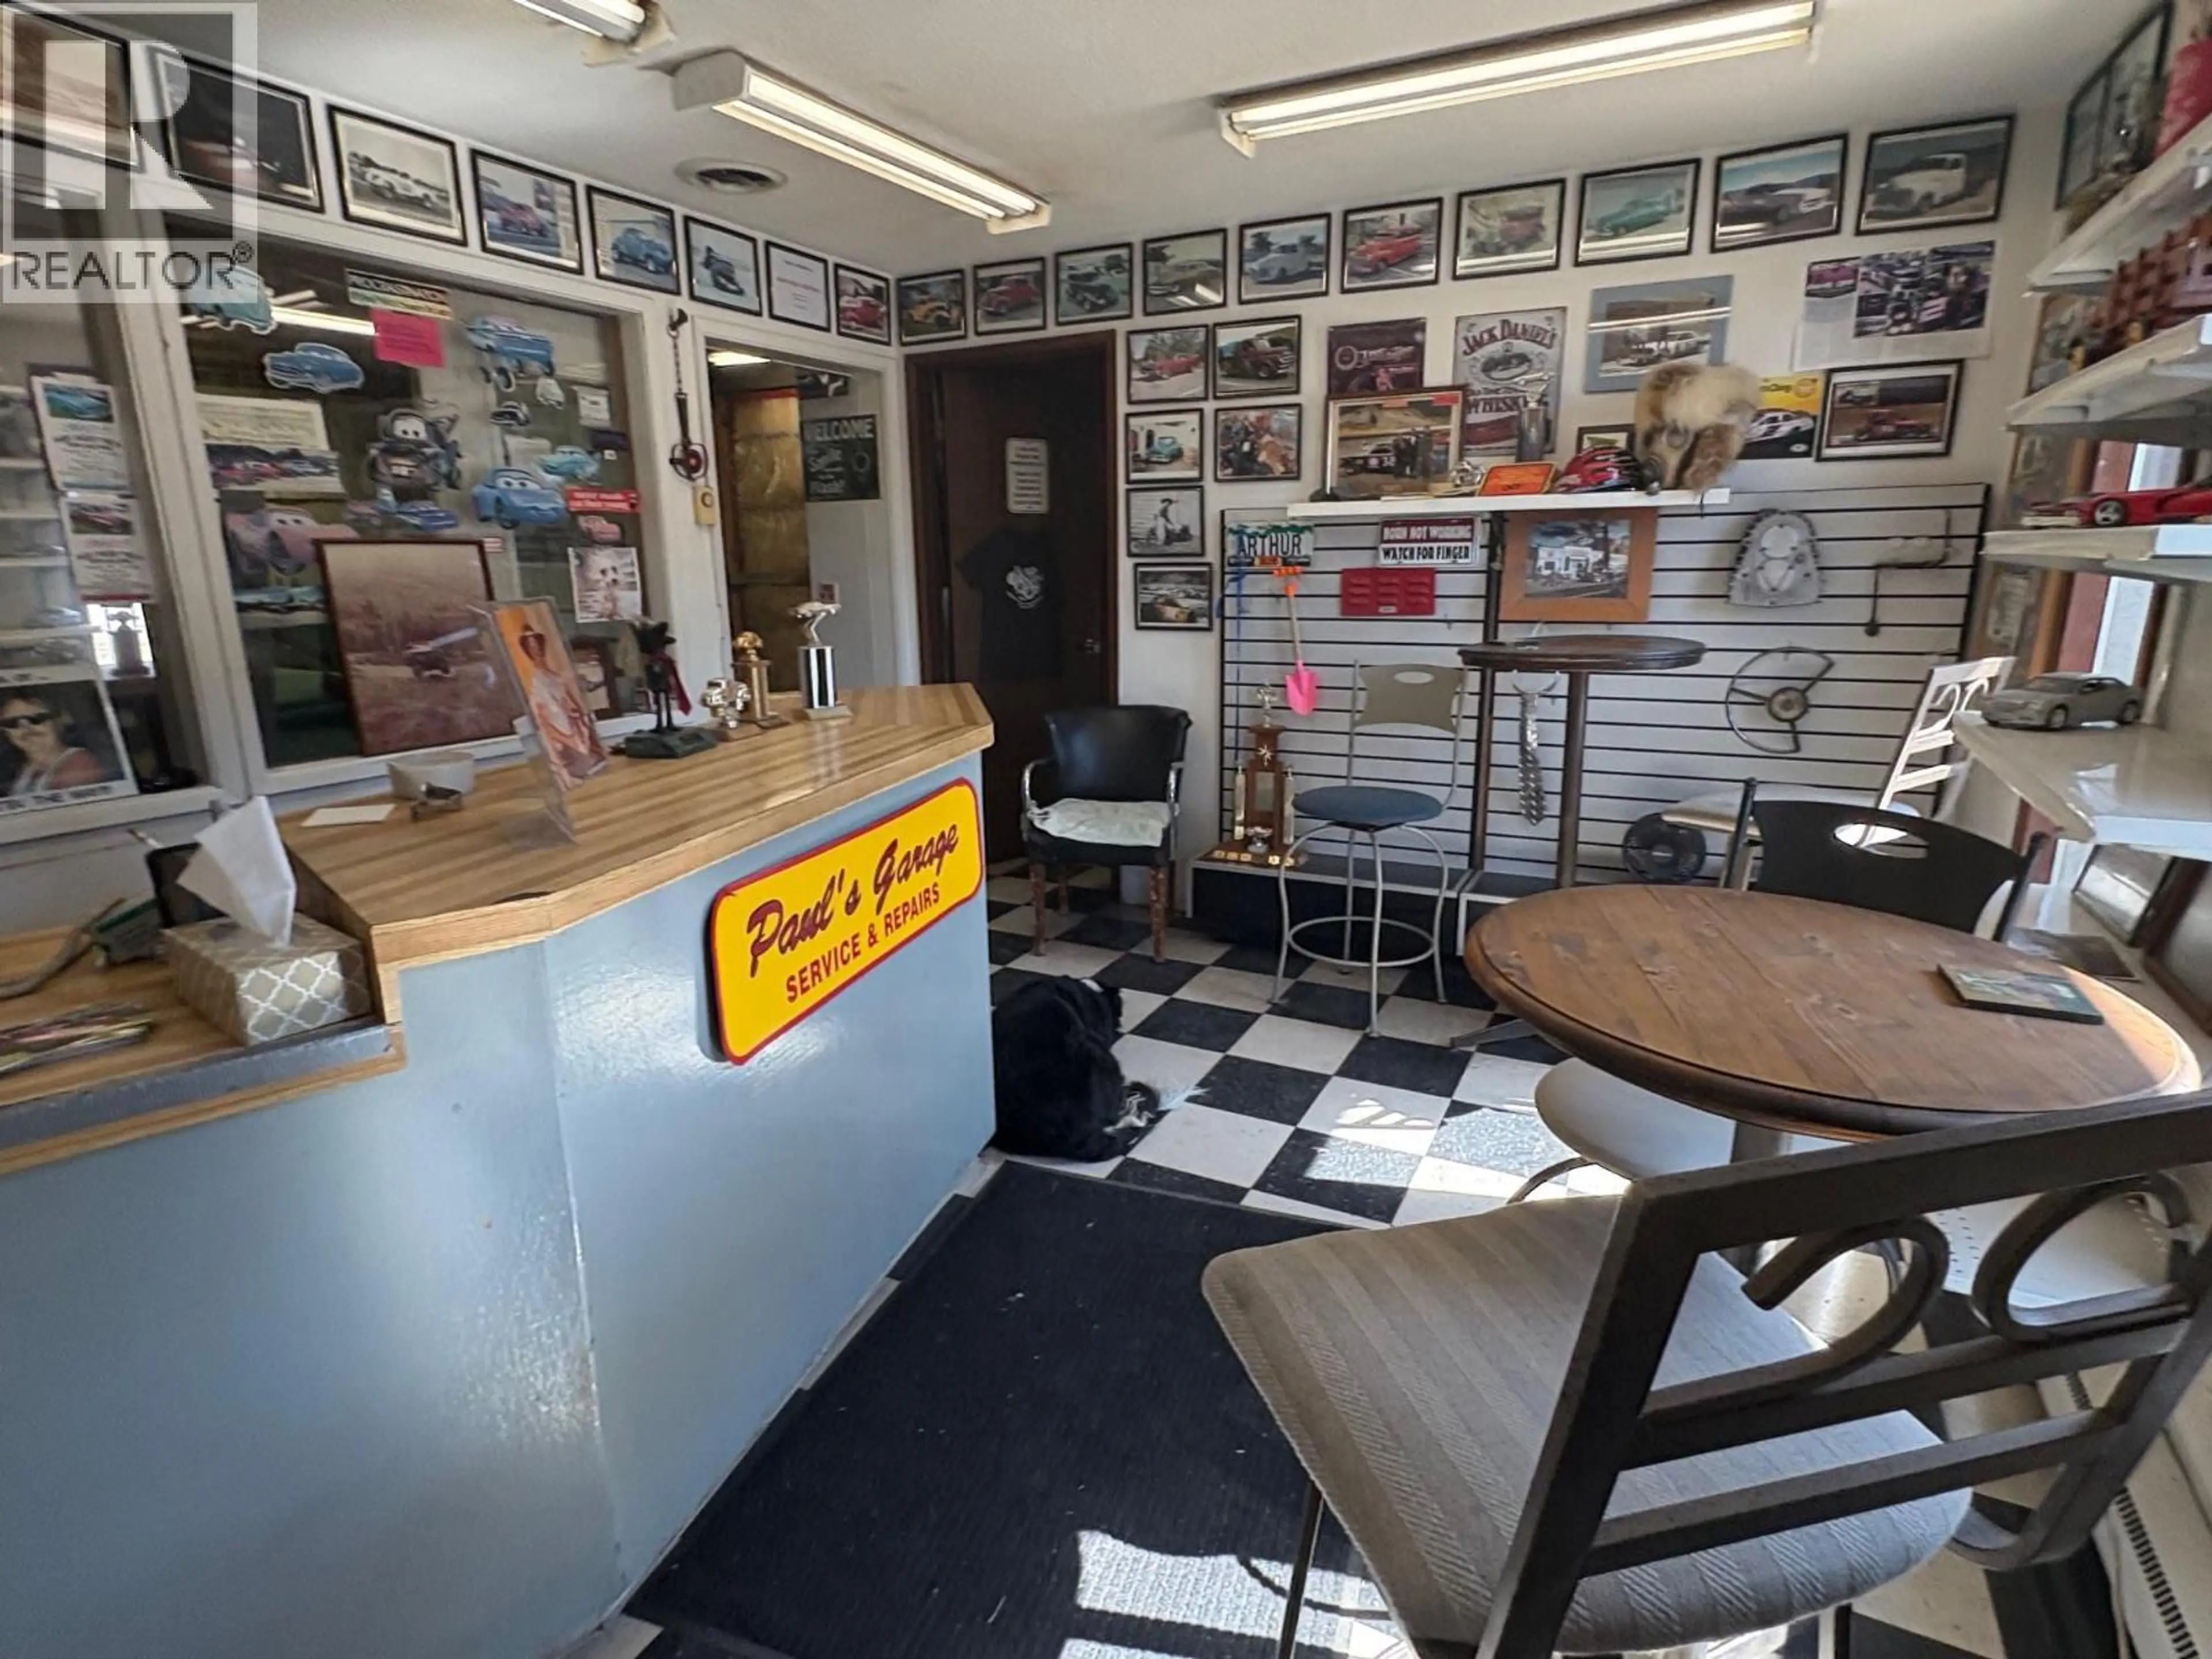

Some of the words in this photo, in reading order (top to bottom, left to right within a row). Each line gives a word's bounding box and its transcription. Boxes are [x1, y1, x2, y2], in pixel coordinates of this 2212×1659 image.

[1463, 325, 1499, 356] JACK
[1237, 532, 1301, 558] ARTHUR
[1384, 547, 1415, 560] WATCH
[1417, 547, 1434, 560] FOR
[1437, 545, 1470, 559] FINGER
[747, 868, 862, 978] Paul's
[873, 824, 960, 916] Garage
[786, 931, 862, 1004] SERVICE
[868, 923, 879, 946] &
[884, 881, 941, 938] REPAIRS
